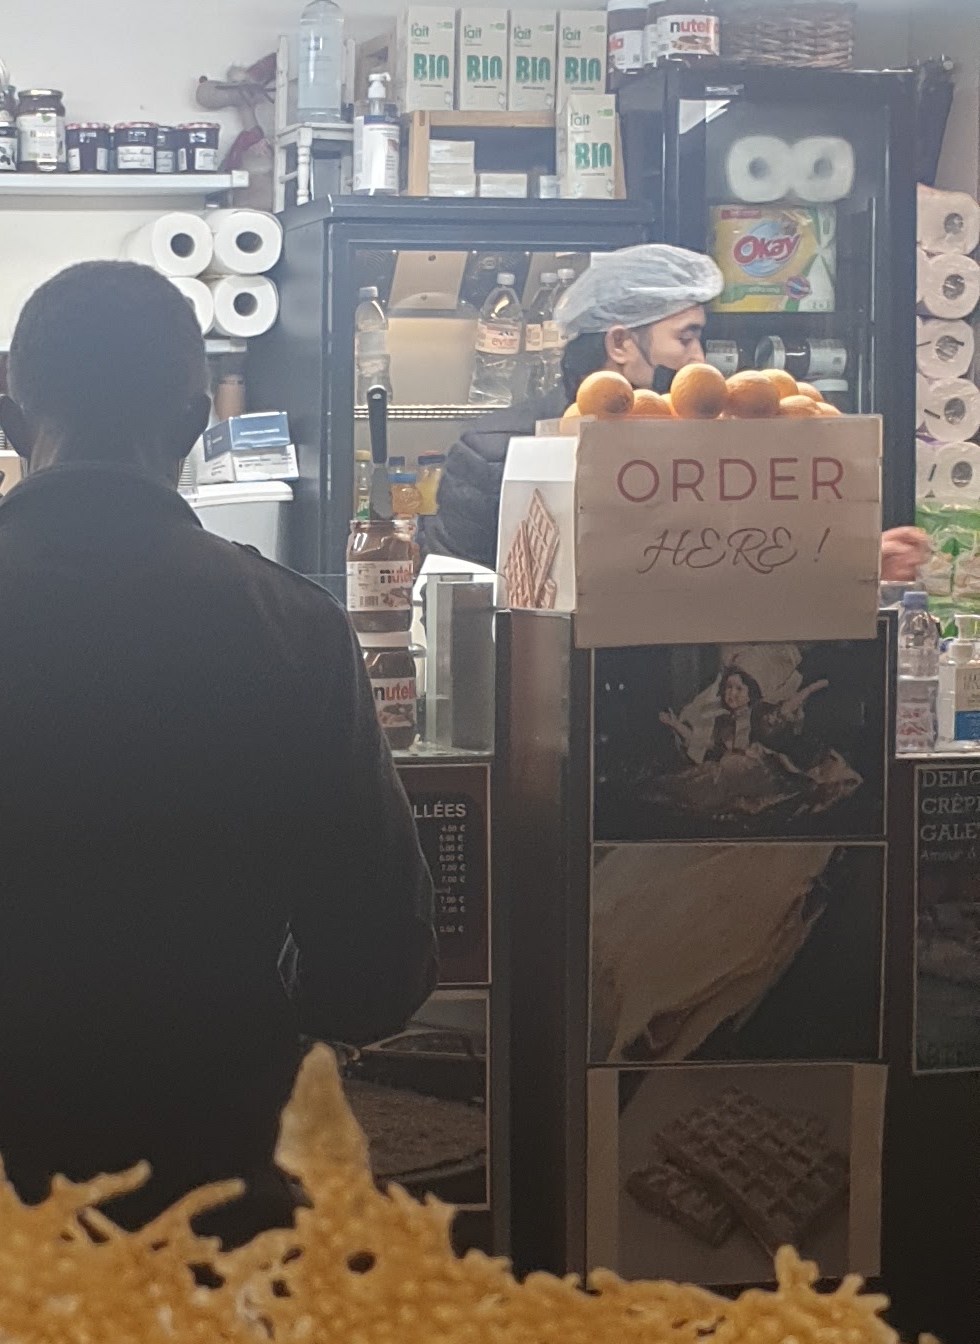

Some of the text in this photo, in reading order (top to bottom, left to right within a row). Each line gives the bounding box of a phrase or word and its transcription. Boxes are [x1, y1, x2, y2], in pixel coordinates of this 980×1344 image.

[411, 24, 429, 38] lait
[464, 26, 482, 39] lait
[513, 27, 532, 40] lait
[562, 29, 581, 42] lait
[413, 53, 450, 81] BIO
[466, 55, 503, 82] BIO
[516, 56, 551, 83] BIO
[564, 57, 601, 84] BIO
[571, 113, 590, 127] lait
[575, 142, 612, 169] BIO
[733, 233, 803, 266] Okay
[617, 456, 844, 504] ORDER
[636, 525, 799, 576] HERE
